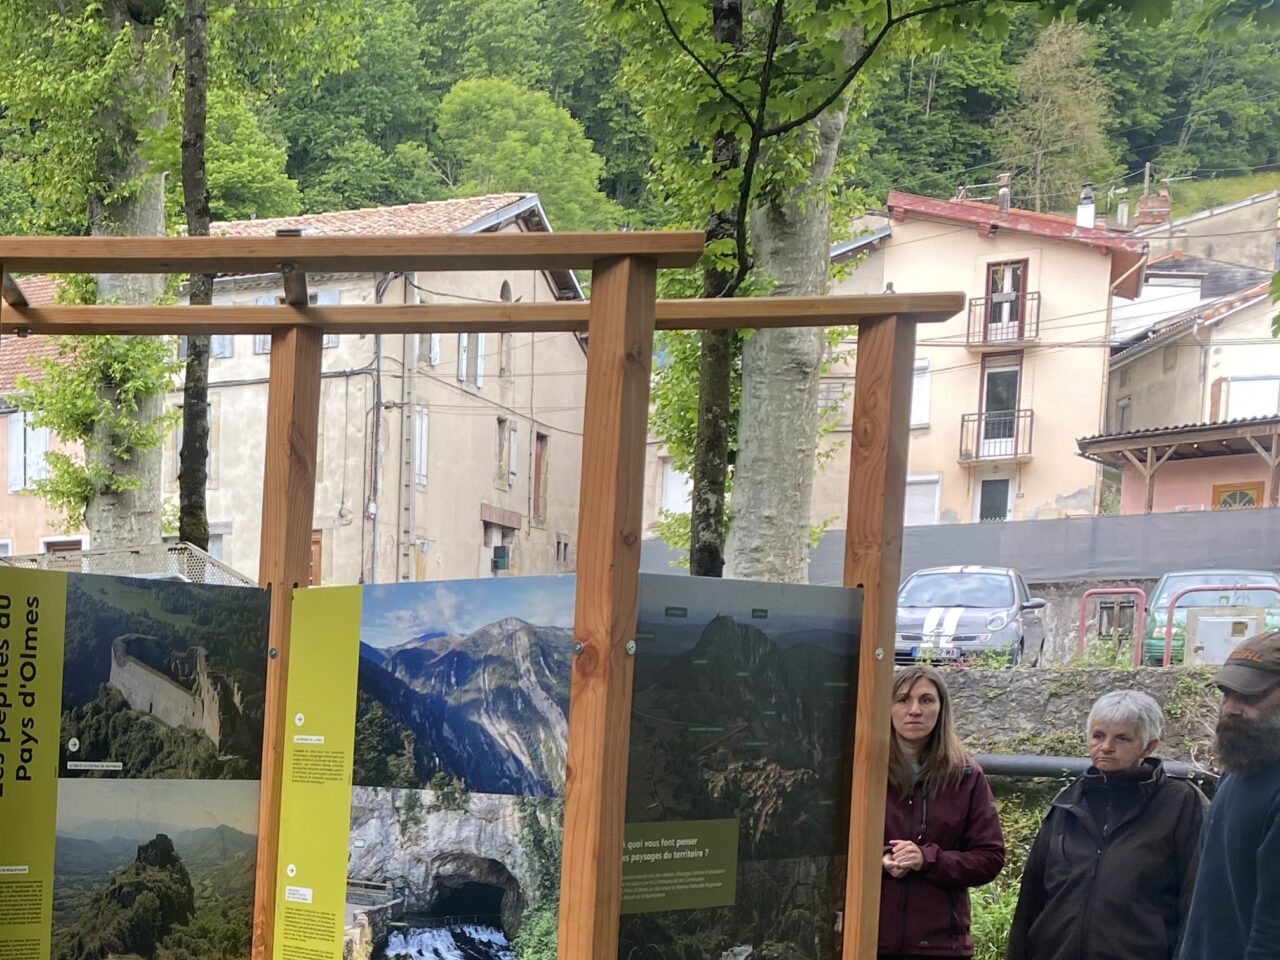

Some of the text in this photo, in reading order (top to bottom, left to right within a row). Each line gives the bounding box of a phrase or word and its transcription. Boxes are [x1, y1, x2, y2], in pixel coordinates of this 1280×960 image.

[16, 596, 39, 780] Pays d'Olmes
[628, 838, 698, 850] quoi vous font penser
[631, 852, 662, 864] paysages
[664, 850, 672, 859] du
[674, 849, 703, 858] territoire
